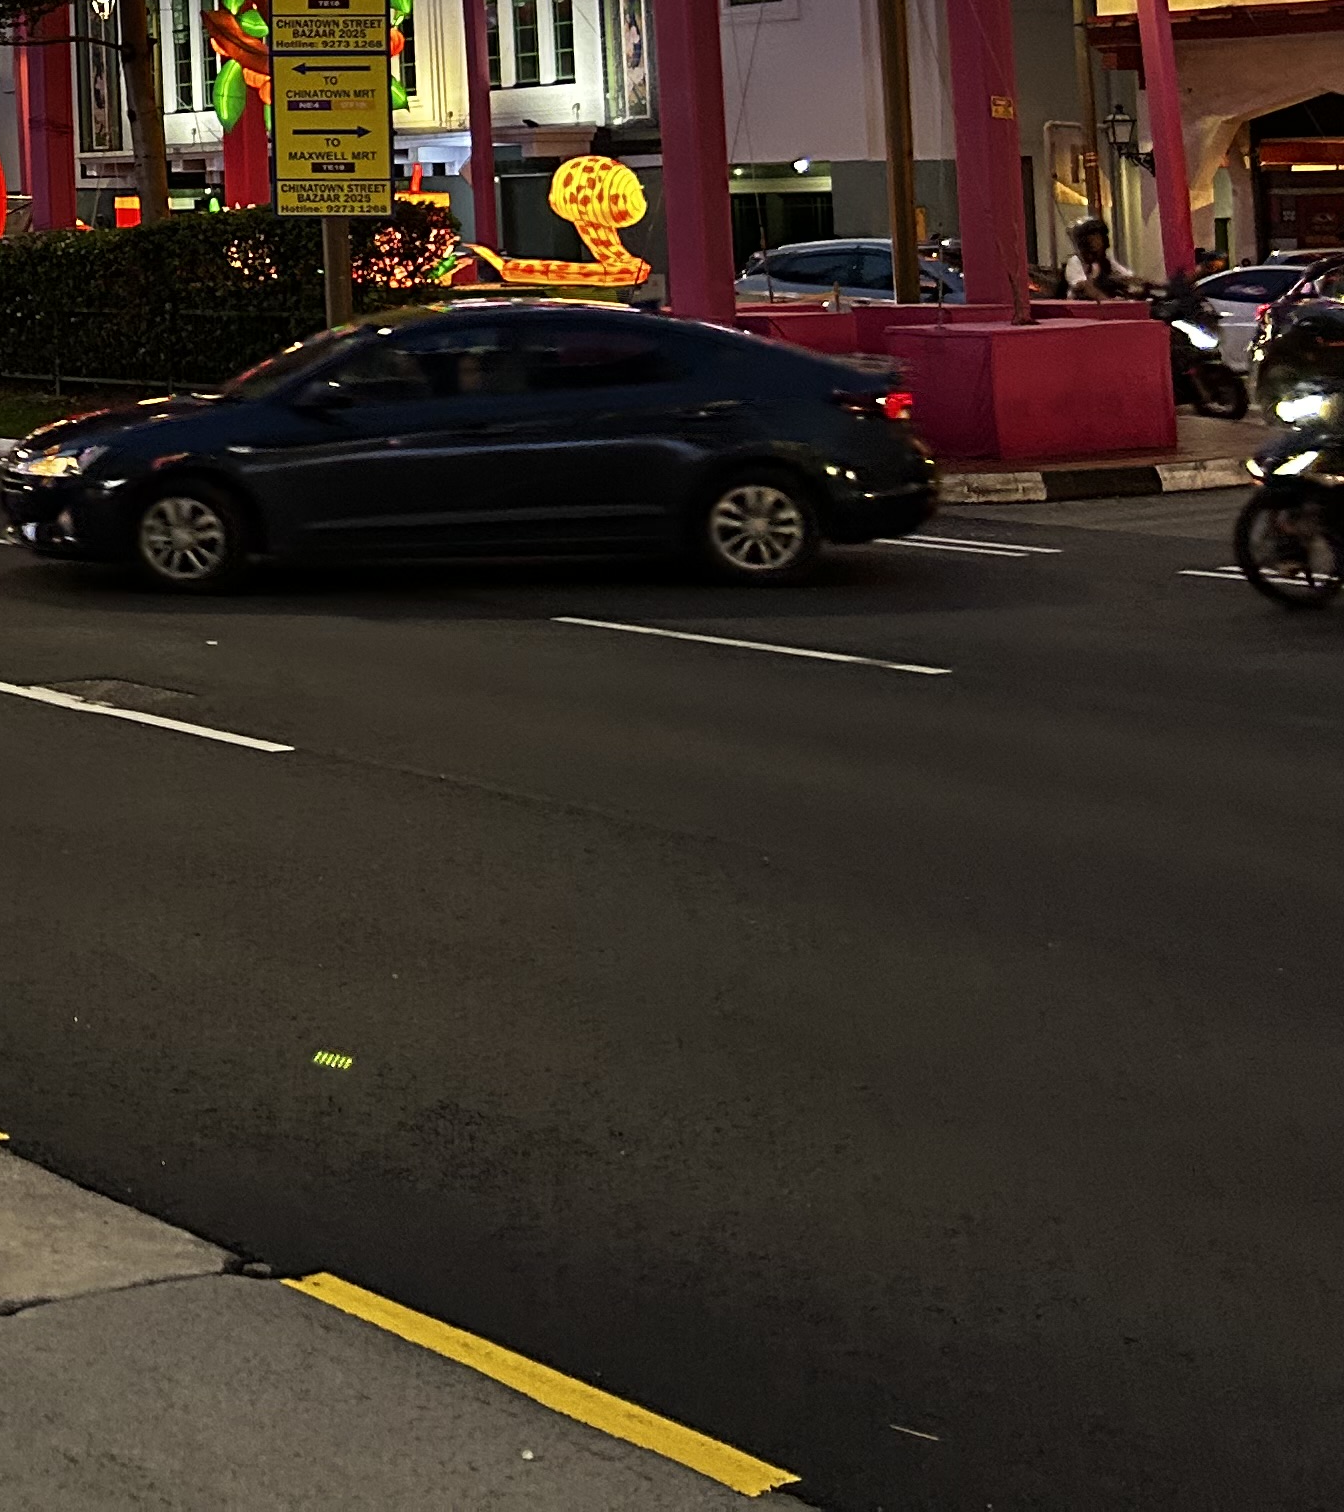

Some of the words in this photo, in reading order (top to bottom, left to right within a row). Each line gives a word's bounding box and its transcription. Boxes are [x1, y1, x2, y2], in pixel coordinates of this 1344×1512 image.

[276, 19, 340, 29] CHINATOWN
[342, 19, 382, 28] STREET
[292, 29, 336, 39] BAZAAR
[338, 29, 367, 38] 2025
[276, 40, 318, 49] Hotline:
[321, 40, 351, 49] 9273
[353, 40, 383, 48] 1268
[323, 76, 338, 85] TO
[286, 89, 351, 99] CHINATOWN
[353, 89, 377, 98] MRT
[323, 138, 341, 147] TO
[288, 152, 348, 161] MAXWELL
[351, 151, 377, 160] MRT
[280, 184, 344, 193] CHINATOWN
[346, 184, 387, 193] STREET
[297, 194, 341, 203] BAZAAR
[343, 194, 371, 203] 2025
[280, 205, 323, 213] Hotline:
[326, 205, 355, 213] 9273
